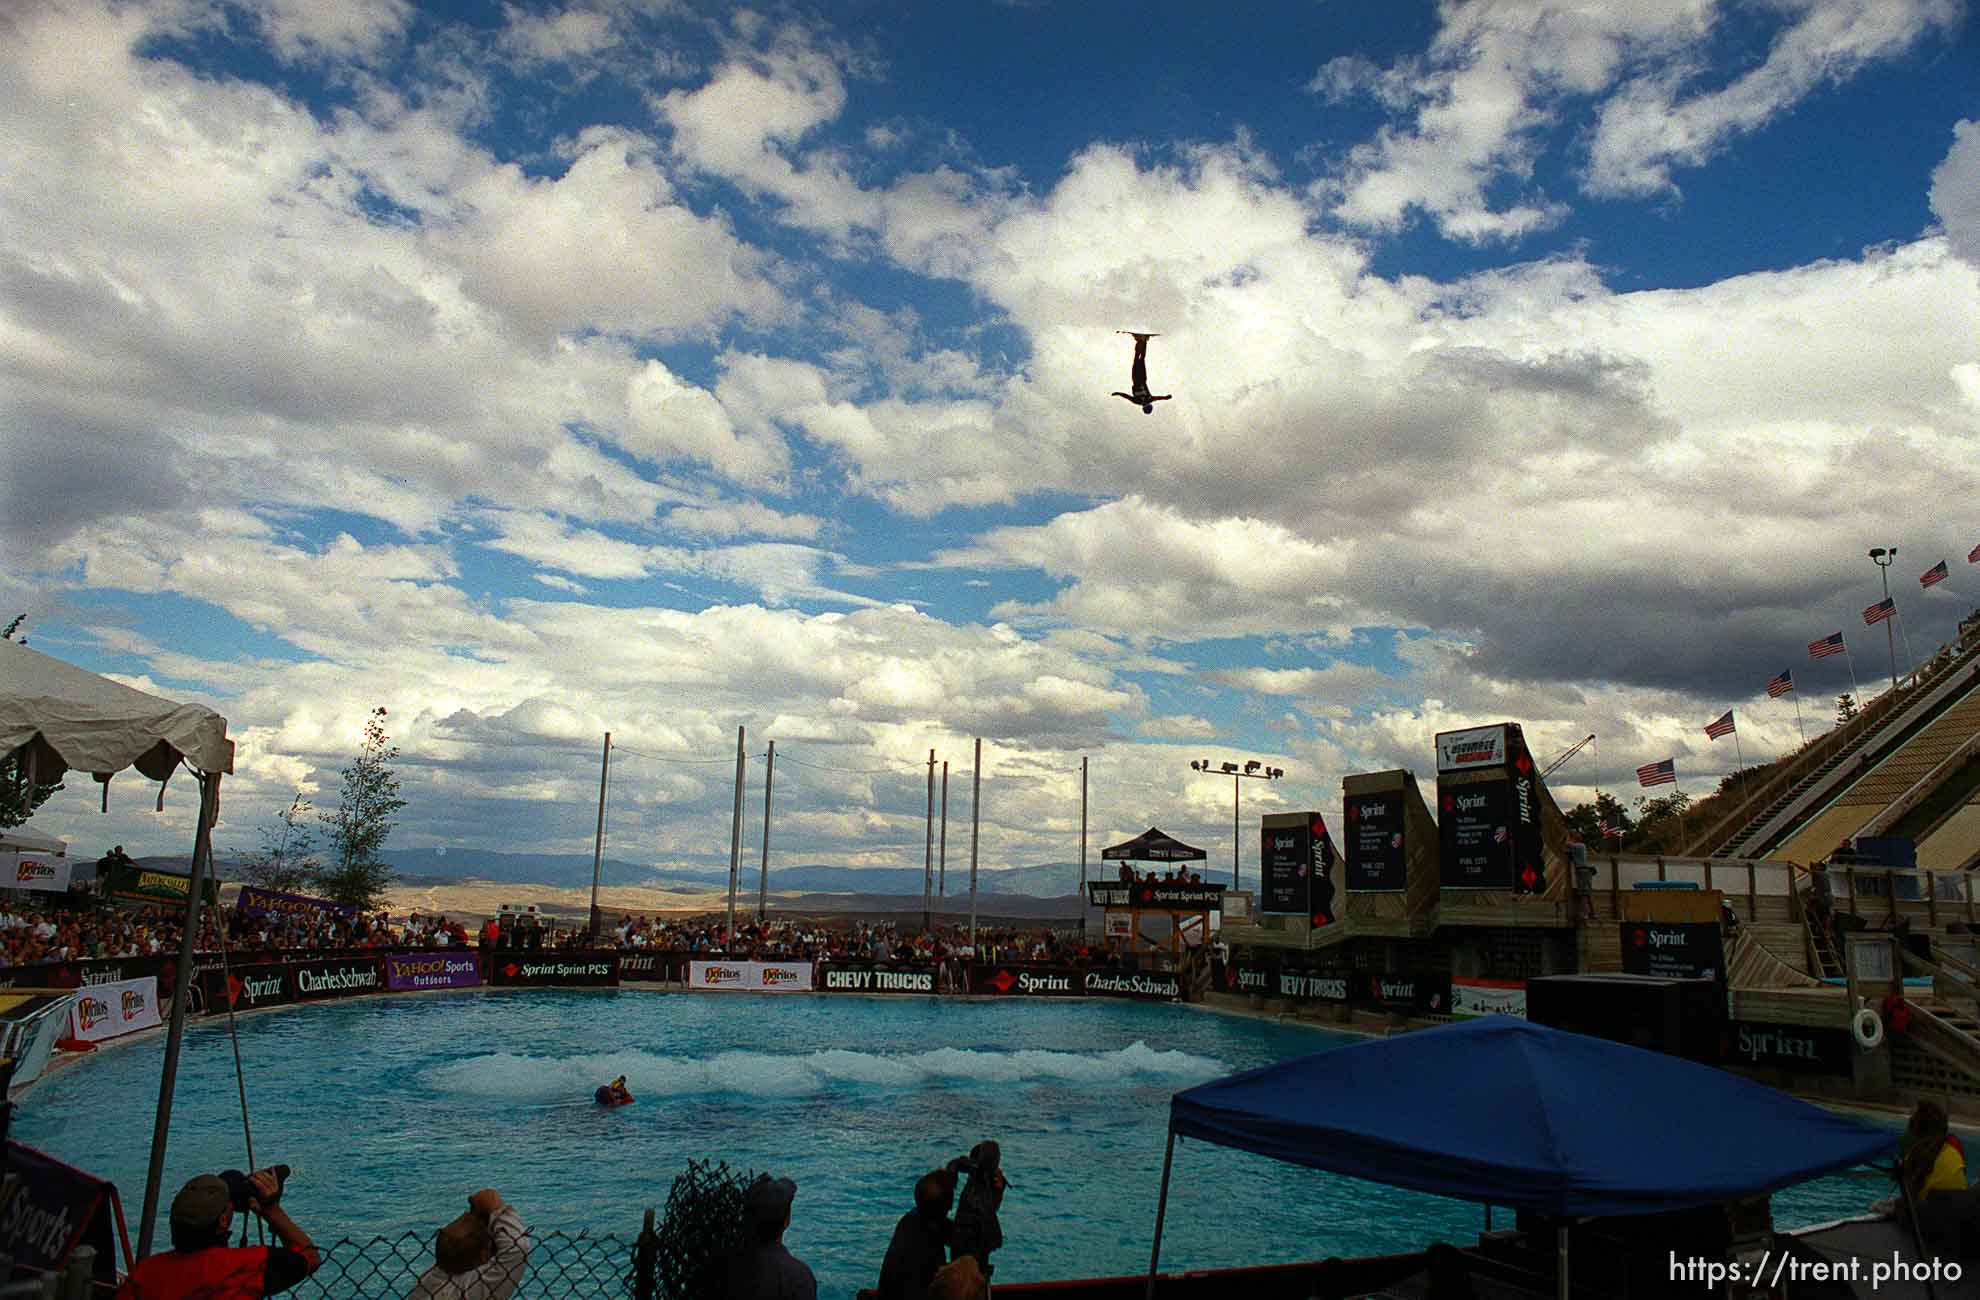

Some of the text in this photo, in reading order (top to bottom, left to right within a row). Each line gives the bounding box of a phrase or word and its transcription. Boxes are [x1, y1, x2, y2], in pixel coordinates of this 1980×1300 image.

[1456, 793, 1488, 814] Sprint
[1515, 777, 1532, 824] Sprint
[1360, 802, 1385, 820] Sprint
[1273, 835, 1296, 851] Sprint
[1312, 839, 1326, 878] Sprint
[17, 861, 56, 881] Doritos
[1153, 887, 1179, 904] Sprint
[1649, 928, 1687, 948] Sprint
[80, 965, 122, 987] Sprint
[392, 959, 475, 978] YAHOO! Sports
[521, 959, 609, 979] Sprint Sprint PCS
[705, 967, 742, 984] Doritos
[762, 968, 798, 985] Doritos
[1237, 967, 1269, 990] Sprint
[243, 972, 285, 1004] Sprint
[414, 974, 452, 986] Outdoors
[826, 970, 932, 991] CHEVY TRUCKS
[1017, 971, 1074, 993] Sprint
[1380, 978, 1416, 1000] Sprint
